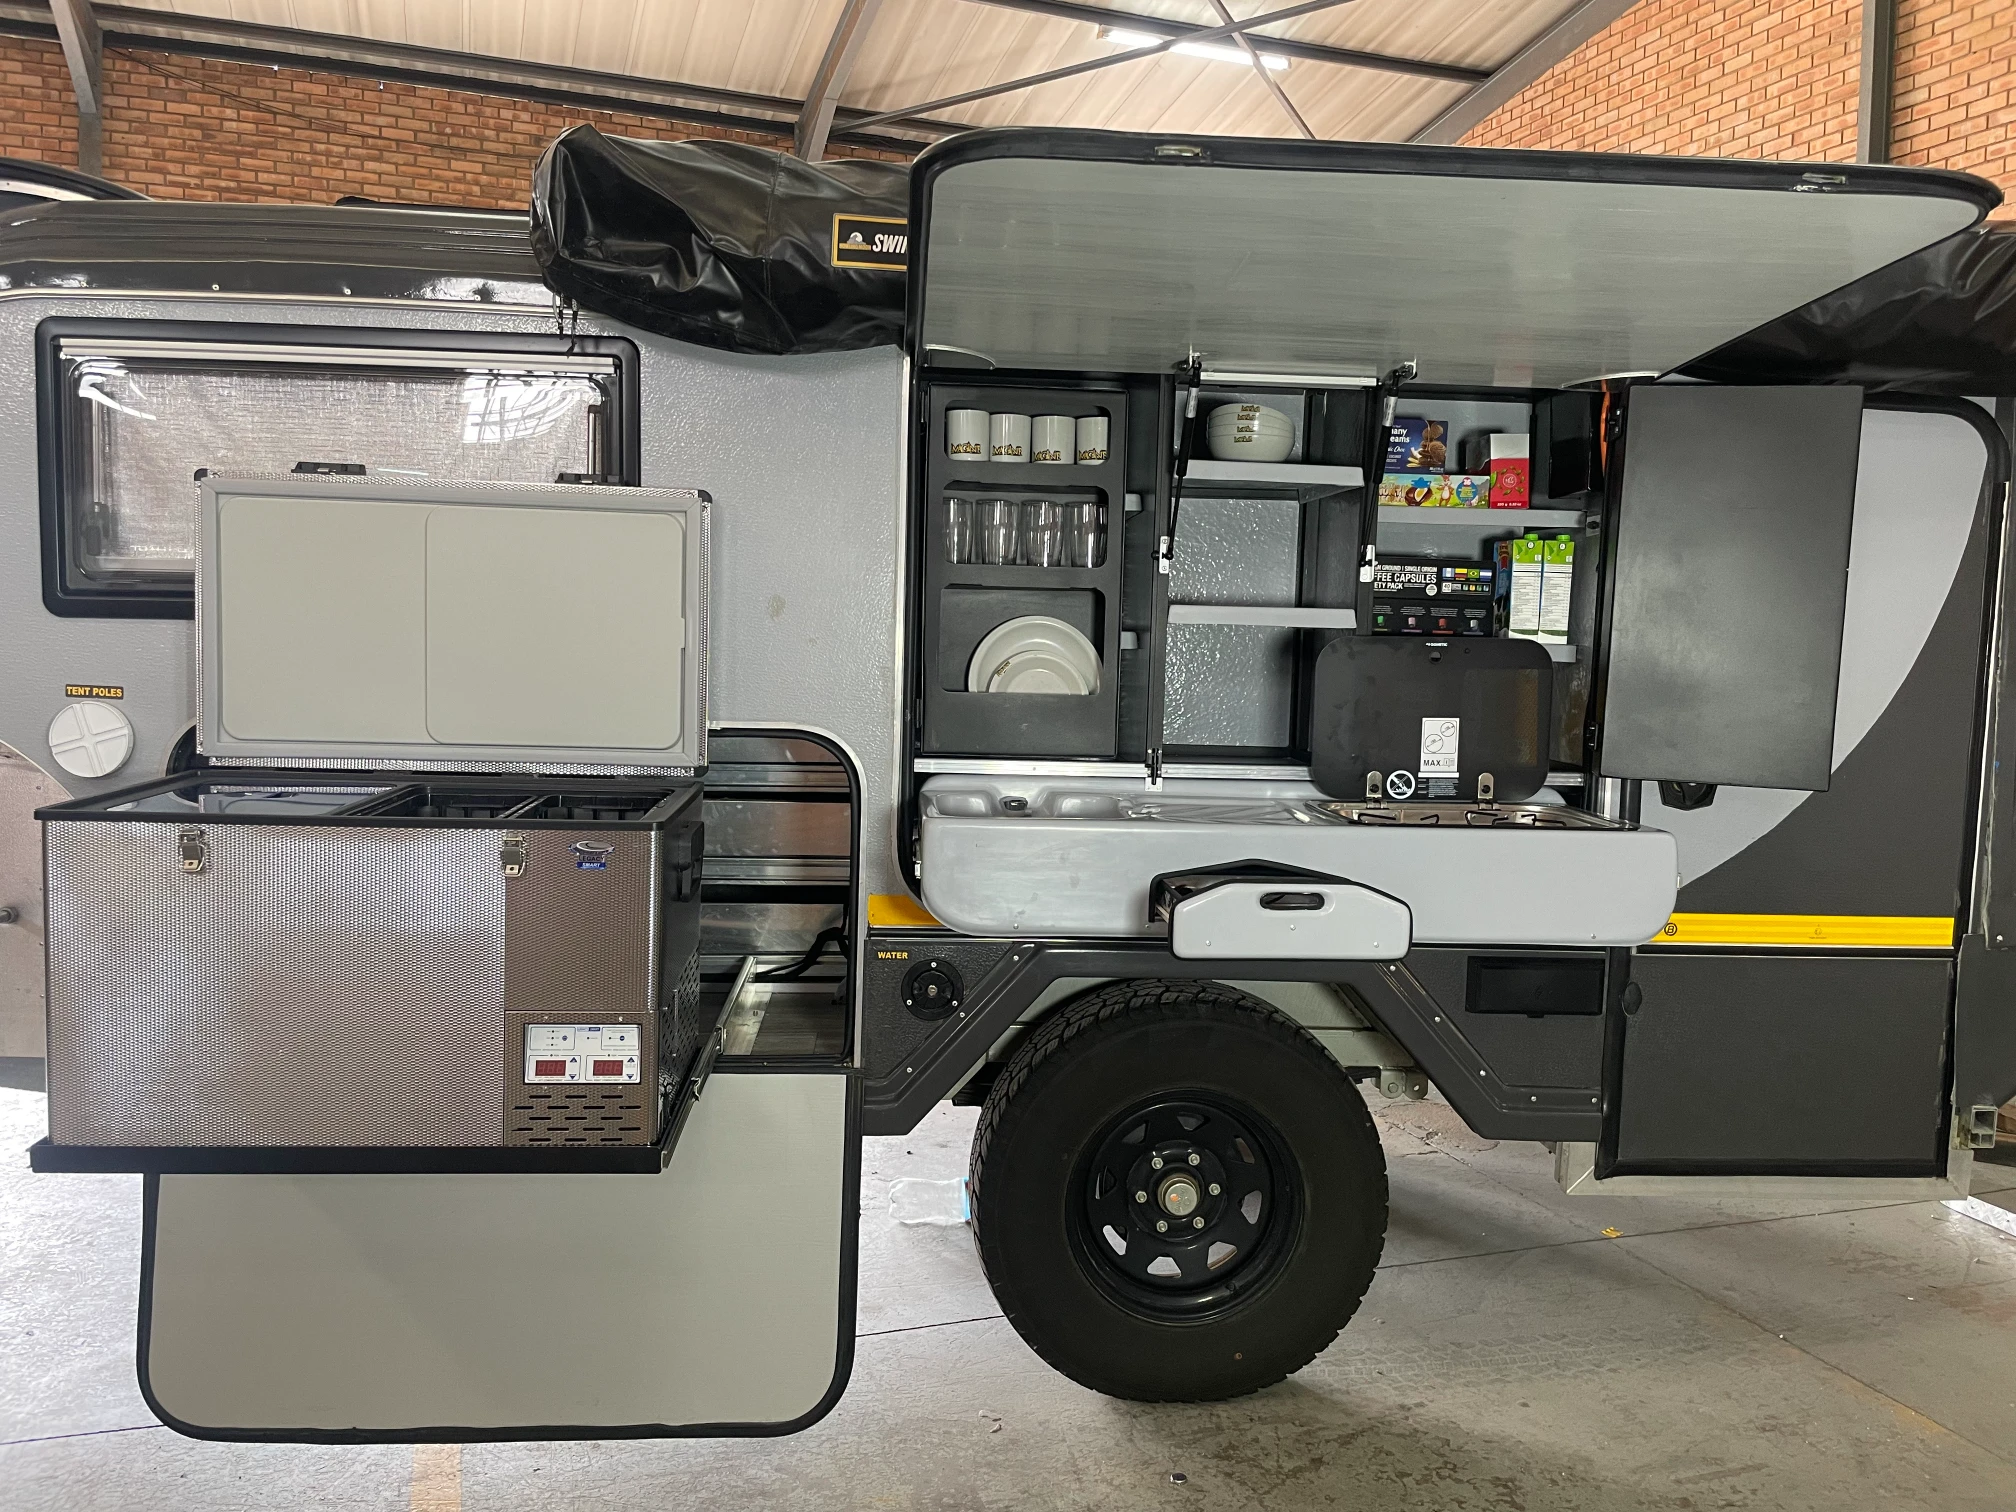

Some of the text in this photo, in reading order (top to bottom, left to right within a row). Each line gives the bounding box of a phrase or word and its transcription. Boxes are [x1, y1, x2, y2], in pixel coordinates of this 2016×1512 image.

[1394, 573, 1437, 584] CAPSULES
[1387, 582, 1403, 590] PACK
[66, 686, 123, 697] TENT POLES
[1423, 759, 1441, 767] MAX
[578, 854, 605, 862] LEGACY
[877, 951, 909, 960] WATER
